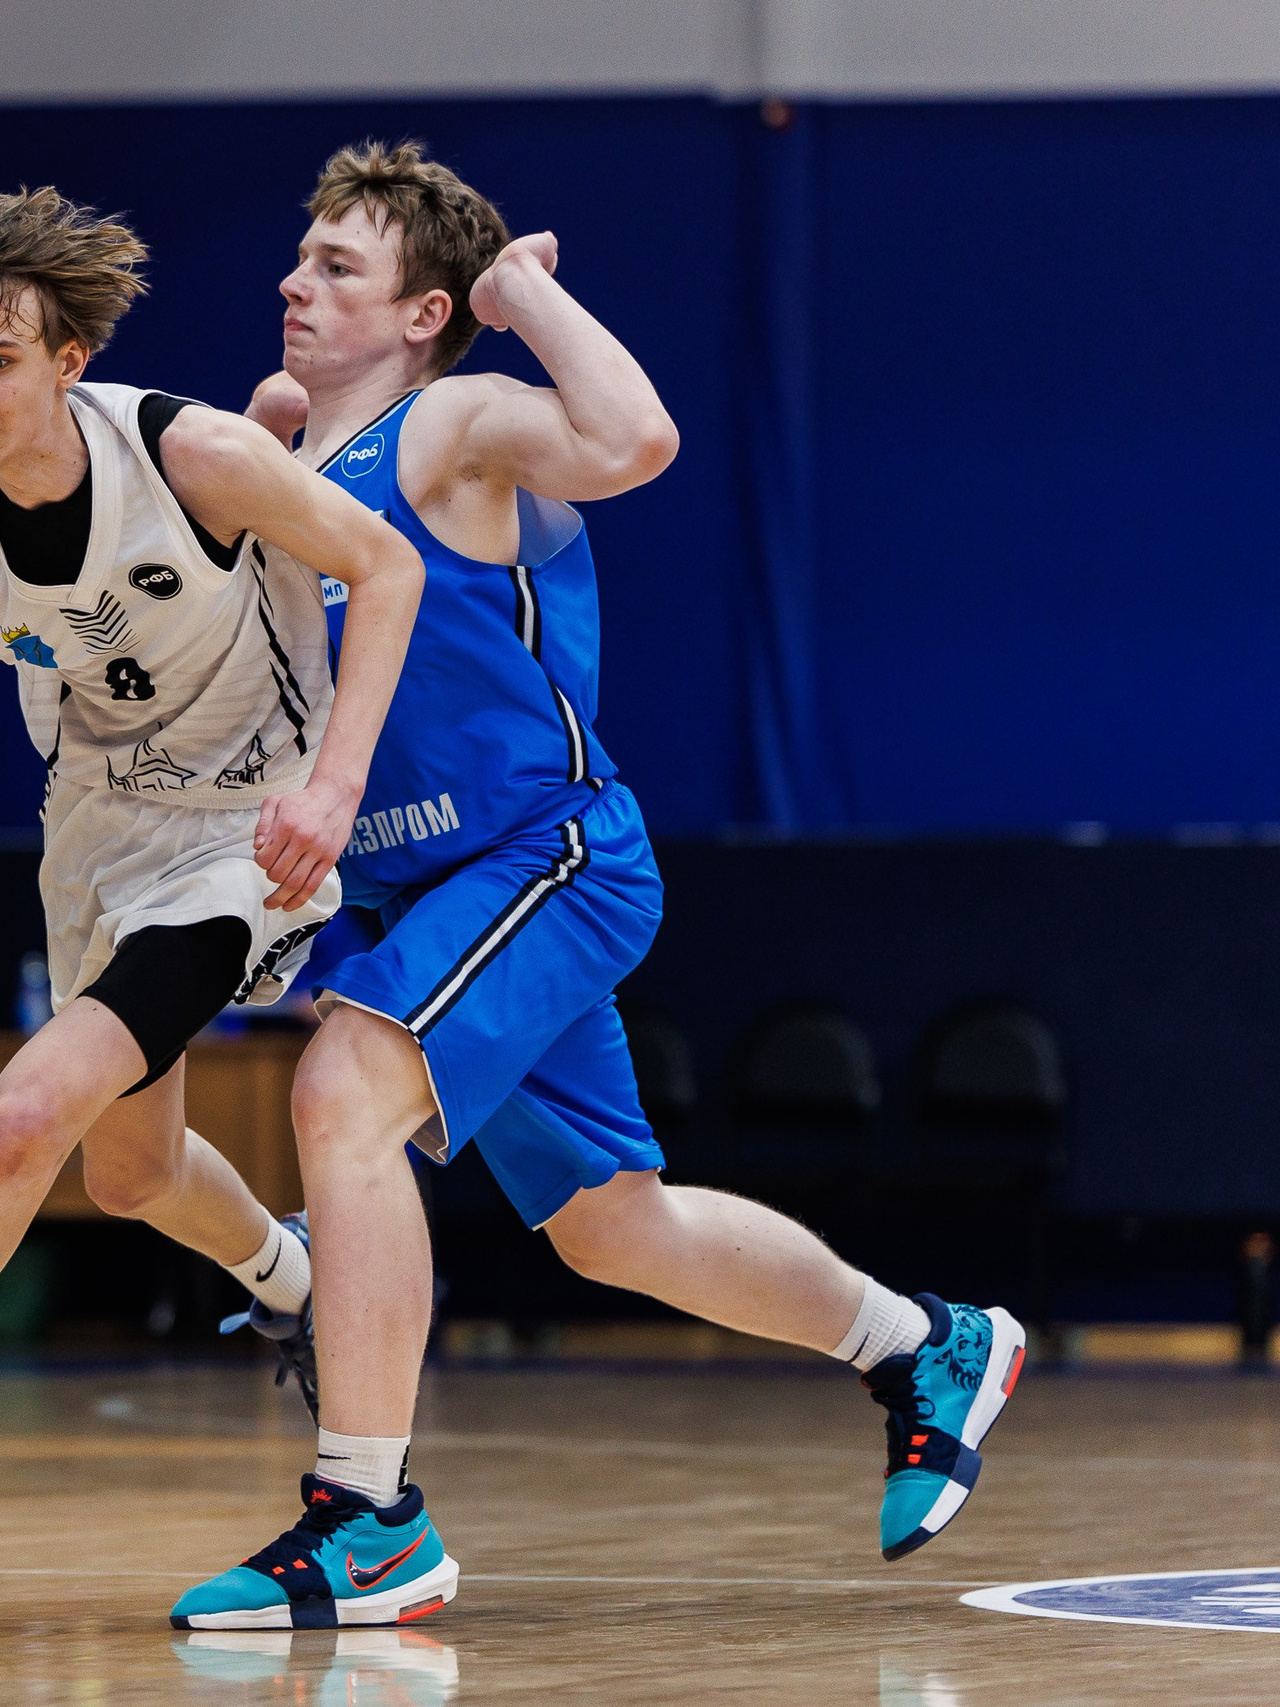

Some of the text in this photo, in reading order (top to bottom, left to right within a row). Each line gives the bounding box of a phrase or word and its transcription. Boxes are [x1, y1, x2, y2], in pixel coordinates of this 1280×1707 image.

[347, 443, 379, 463] РФБ
[138, 570, 174, 587] РФБ
[338, 793, 460, 858] АЗПРОМ
